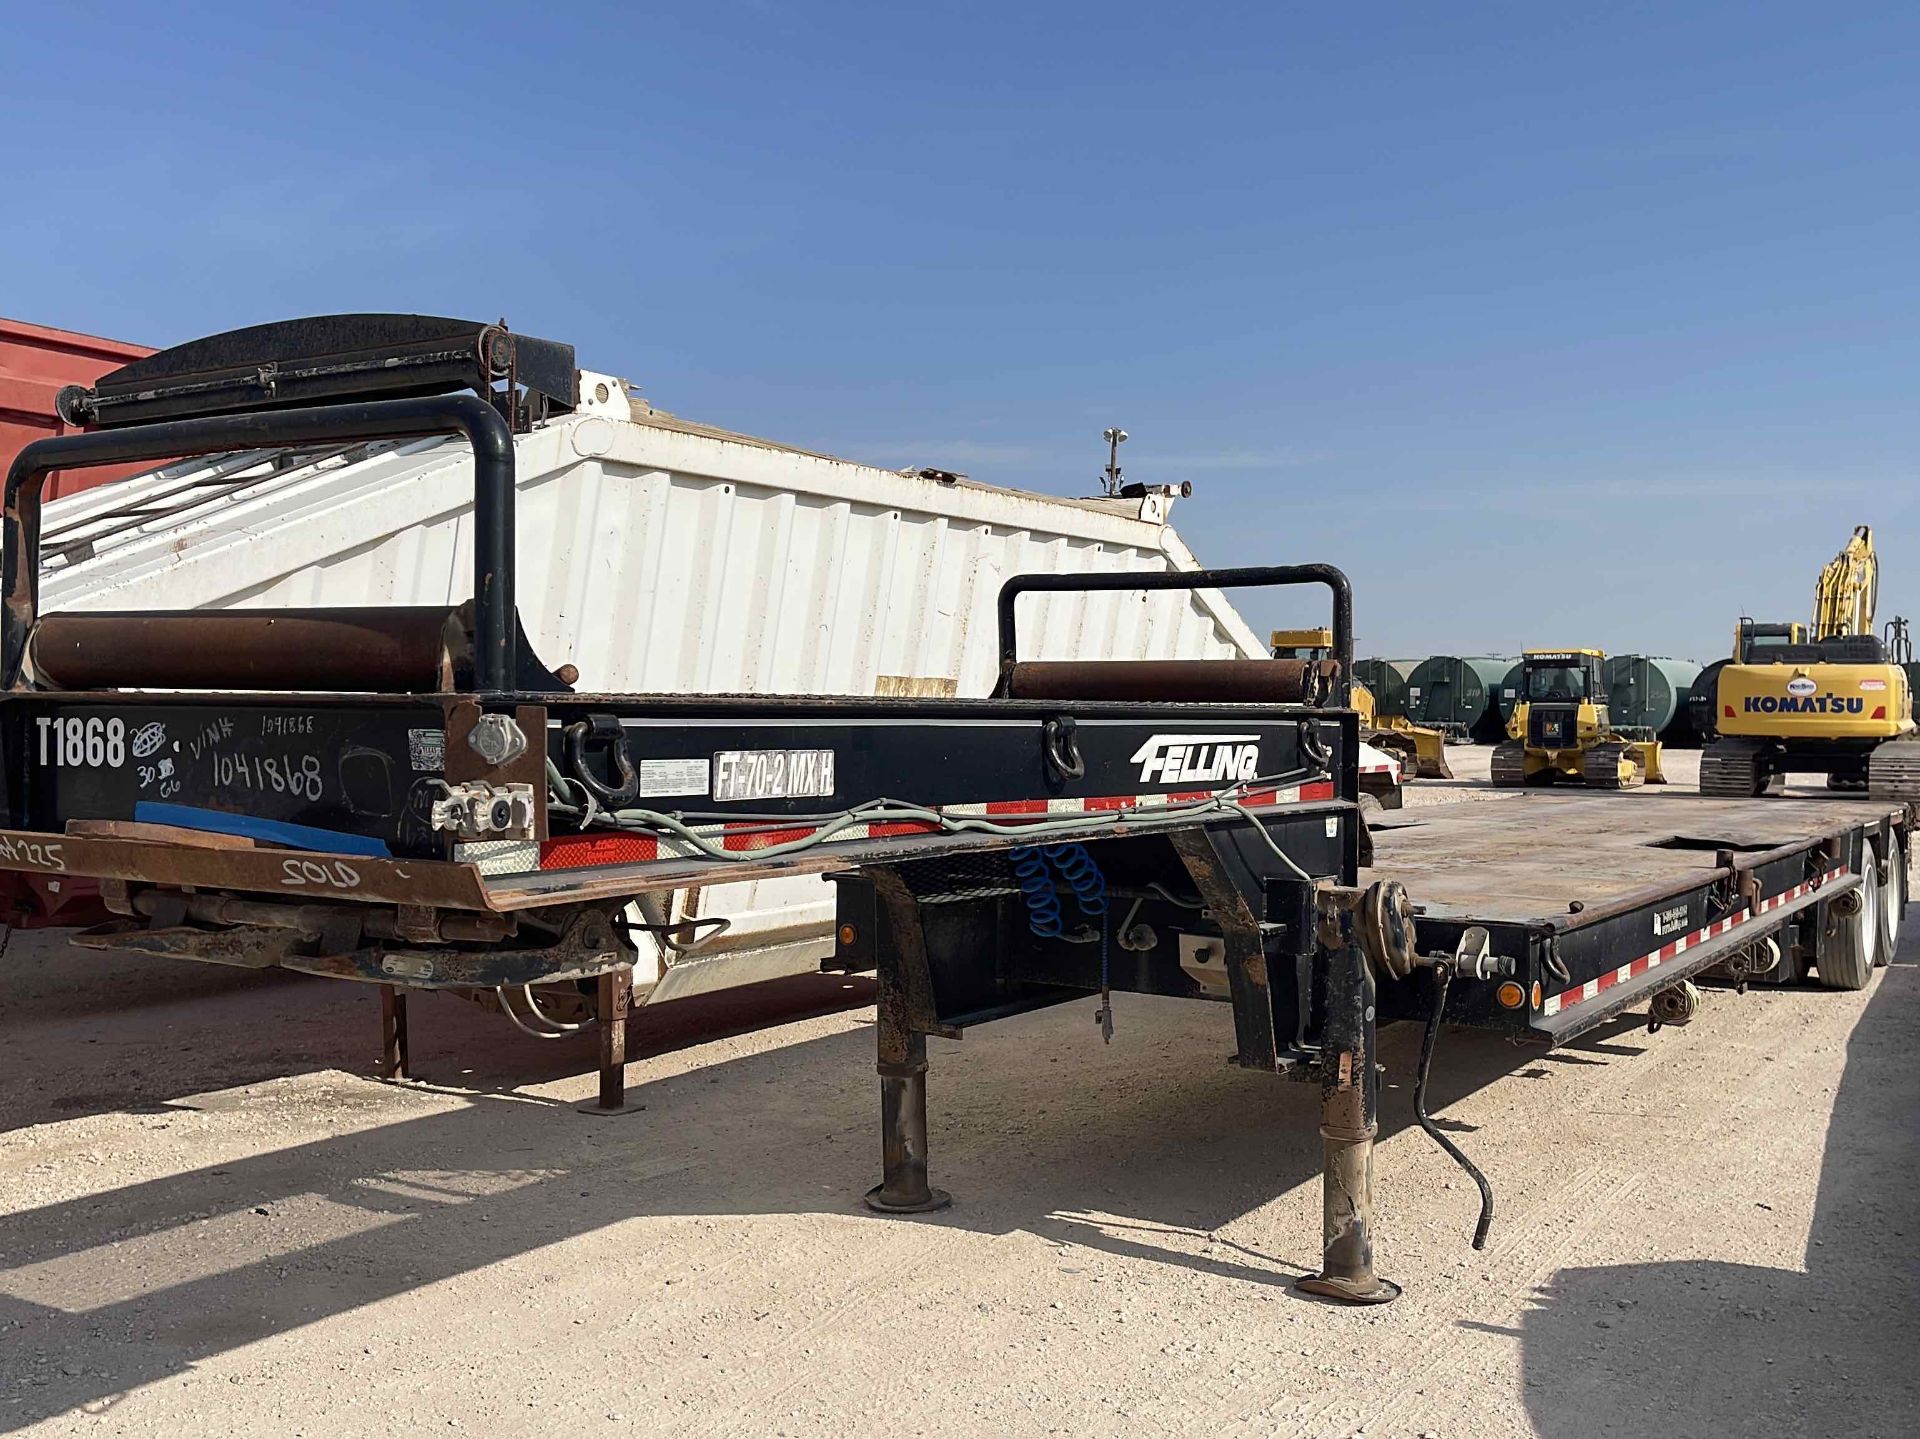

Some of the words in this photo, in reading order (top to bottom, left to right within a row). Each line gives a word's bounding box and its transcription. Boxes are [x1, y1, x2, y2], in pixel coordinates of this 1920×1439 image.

[1744, 694, 1863, 713] KOMATSU
[36, 717, 125, 768] T1868
[1130, 734, 1261, 783] FELLING
[213, 752, 323, 801] 1041868
[716, 753, 785, 799] FT-70-2
[281, 859, 361, 888] SOLD
